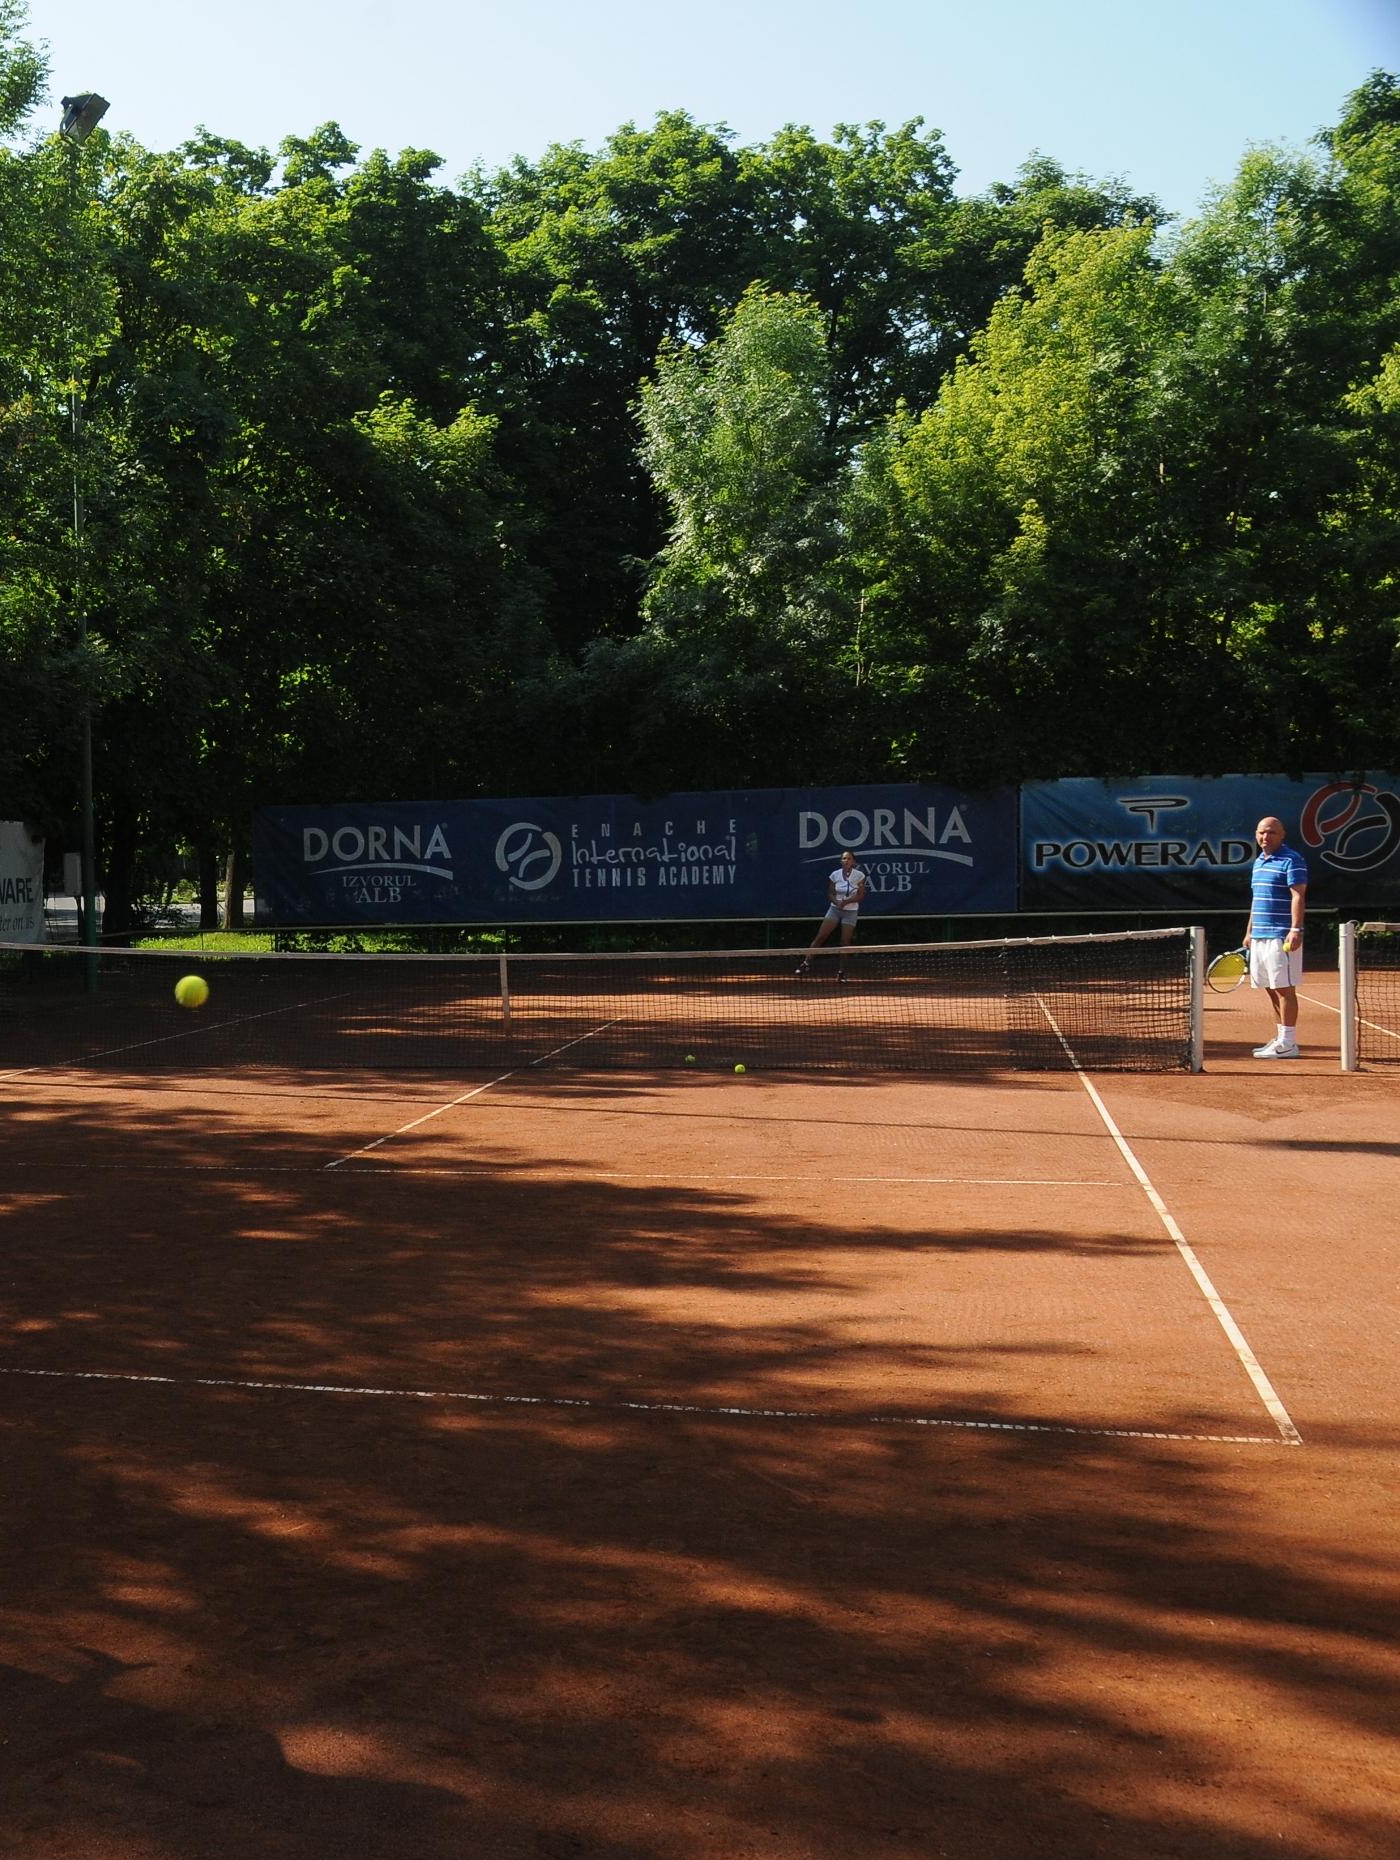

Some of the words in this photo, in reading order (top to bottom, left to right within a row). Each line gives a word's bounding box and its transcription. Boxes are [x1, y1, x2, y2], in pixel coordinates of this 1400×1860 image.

[571, 818, 737, 838] ENACHE
[798, 805, 973, 849] DORNA
[303, 823, 453, 862] DORNA
[571, 836, 737, 866] International
[1035, 840, 1254, 868] POWERAD
[573, 866, 647, 889] TENNIS
[657, 864, 737, 887] ACADEMY
[857, 861, 930, 875] VORUL
[342, 874, 417, 888] IZVORUL
[865, 874, 913, 894] ALB
[356, 886, 403, 905] ALB
